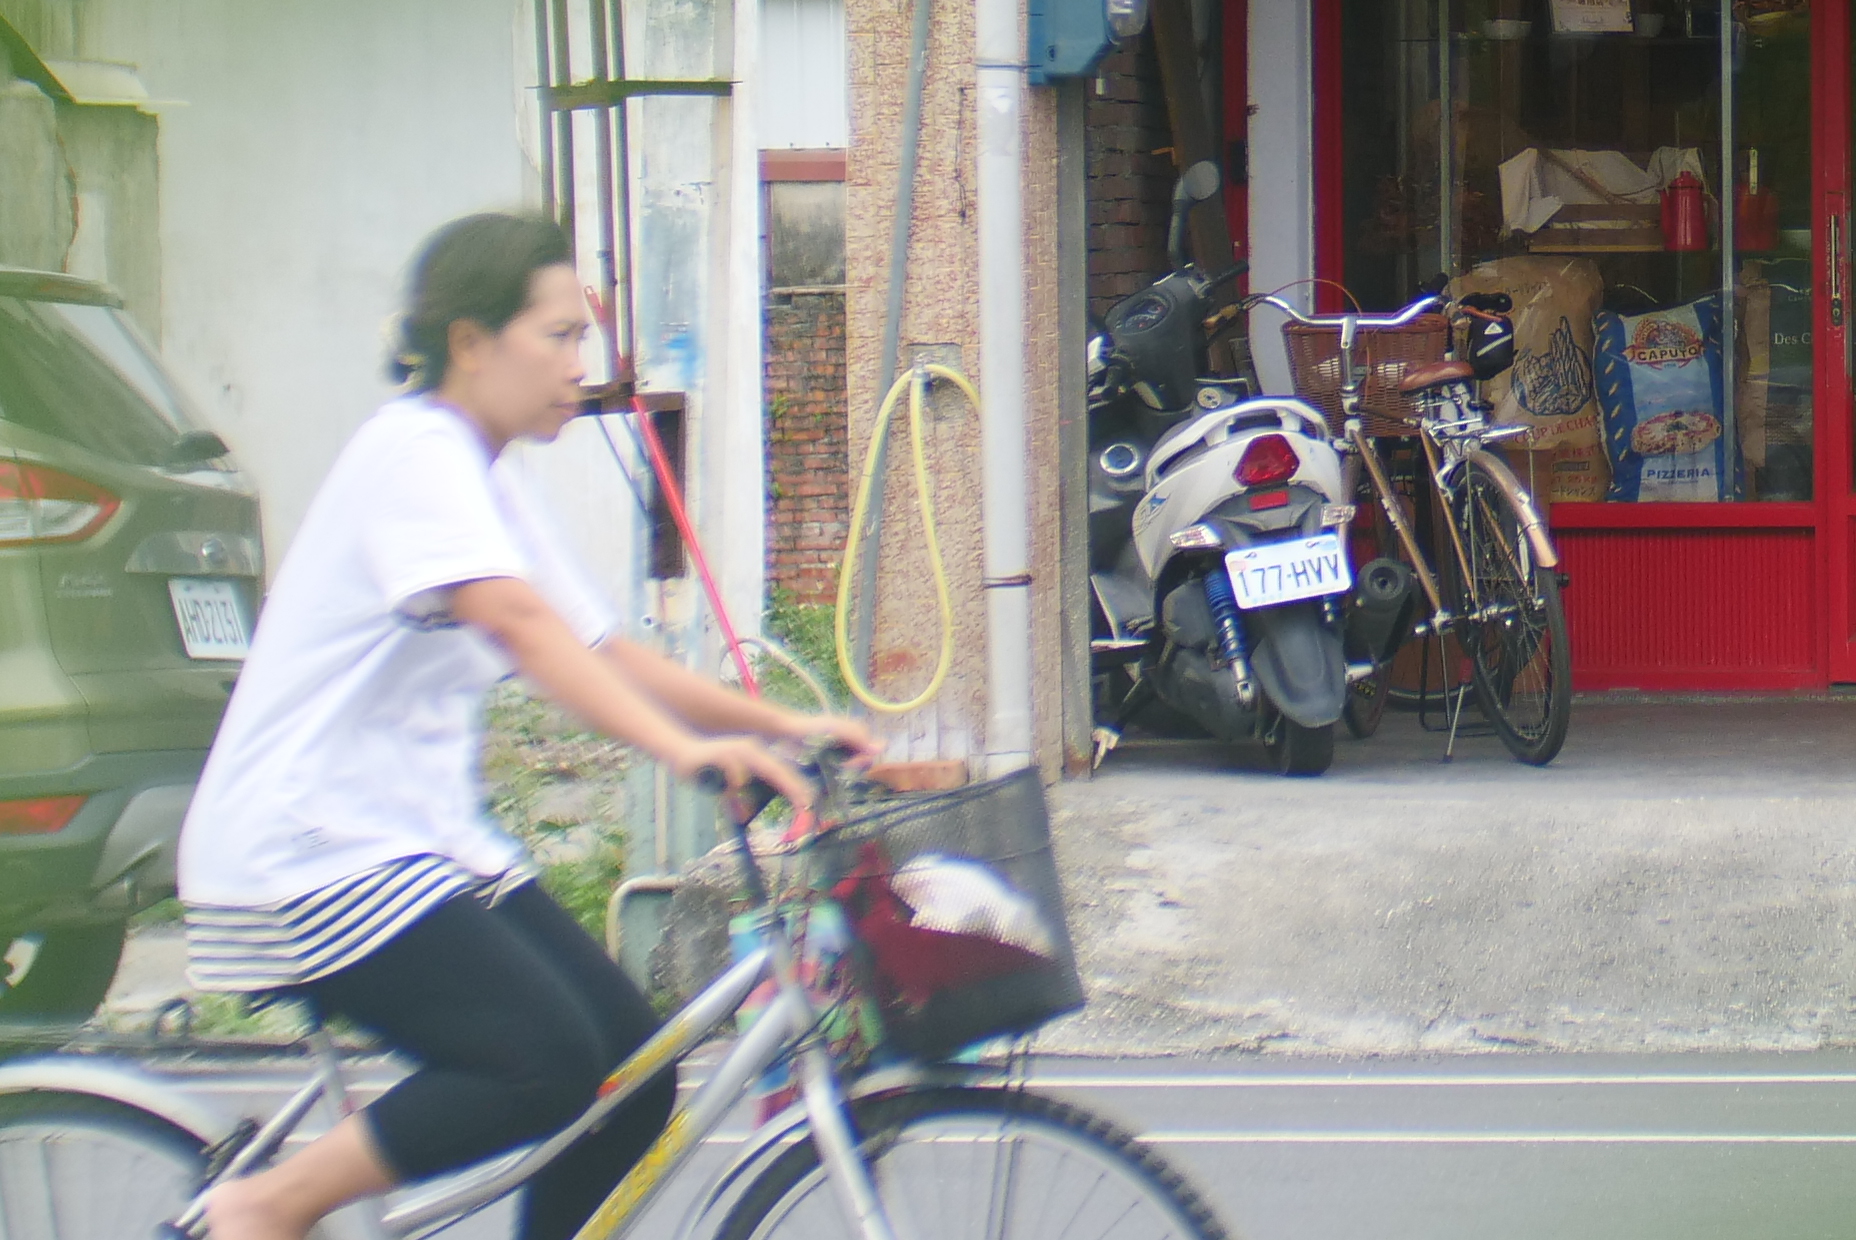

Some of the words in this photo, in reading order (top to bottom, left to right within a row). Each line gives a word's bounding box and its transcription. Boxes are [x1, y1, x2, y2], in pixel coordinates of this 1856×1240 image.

[1774, 332, 1798, 345] Des
[1637, 346, 1699, 362] CAPUTO
[1646, 467, 1711, 479] PIZZERIA
